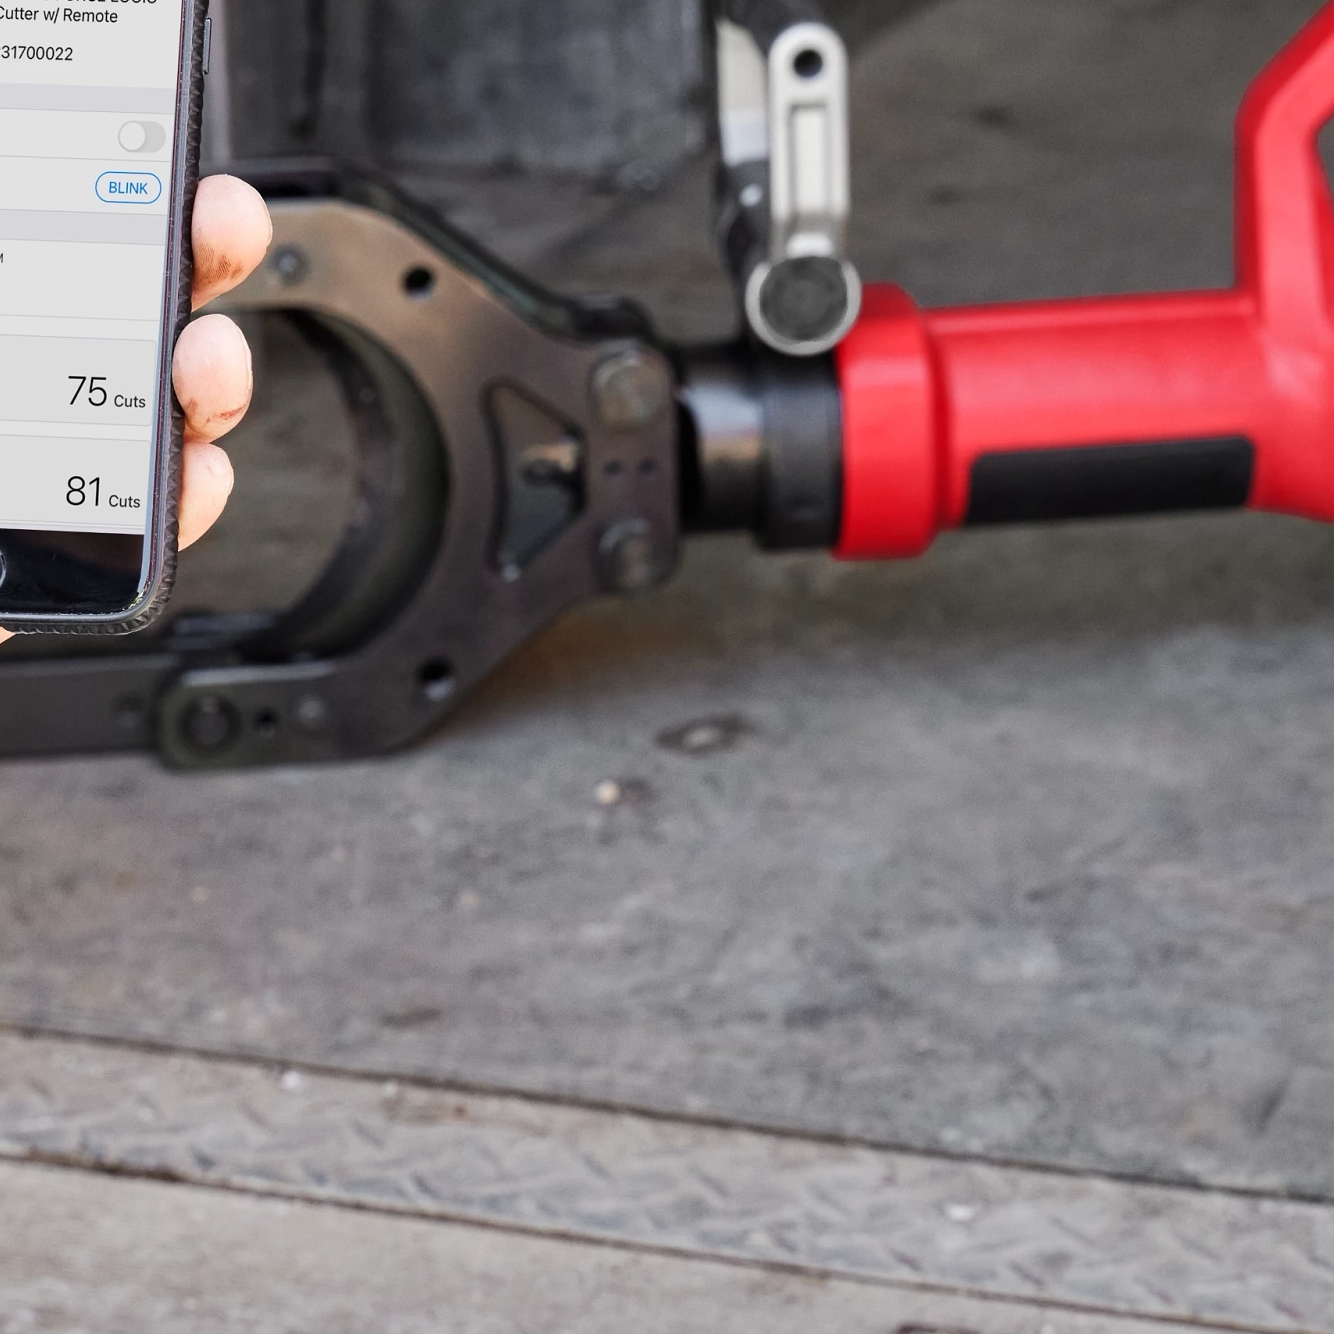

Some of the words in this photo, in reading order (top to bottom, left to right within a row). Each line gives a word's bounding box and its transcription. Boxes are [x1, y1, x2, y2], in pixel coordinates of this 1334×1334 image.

[42, 7, 60, 25] w/
[63, 7, 118, 24] Remote
[108, 181, 148, 195] BLINK
[67, 375, 108, 407] 75
[113, 394, 146, 409] Cuts
[65, 475, 100, 507] 81
[108, 494, 141, 509] Cuts
